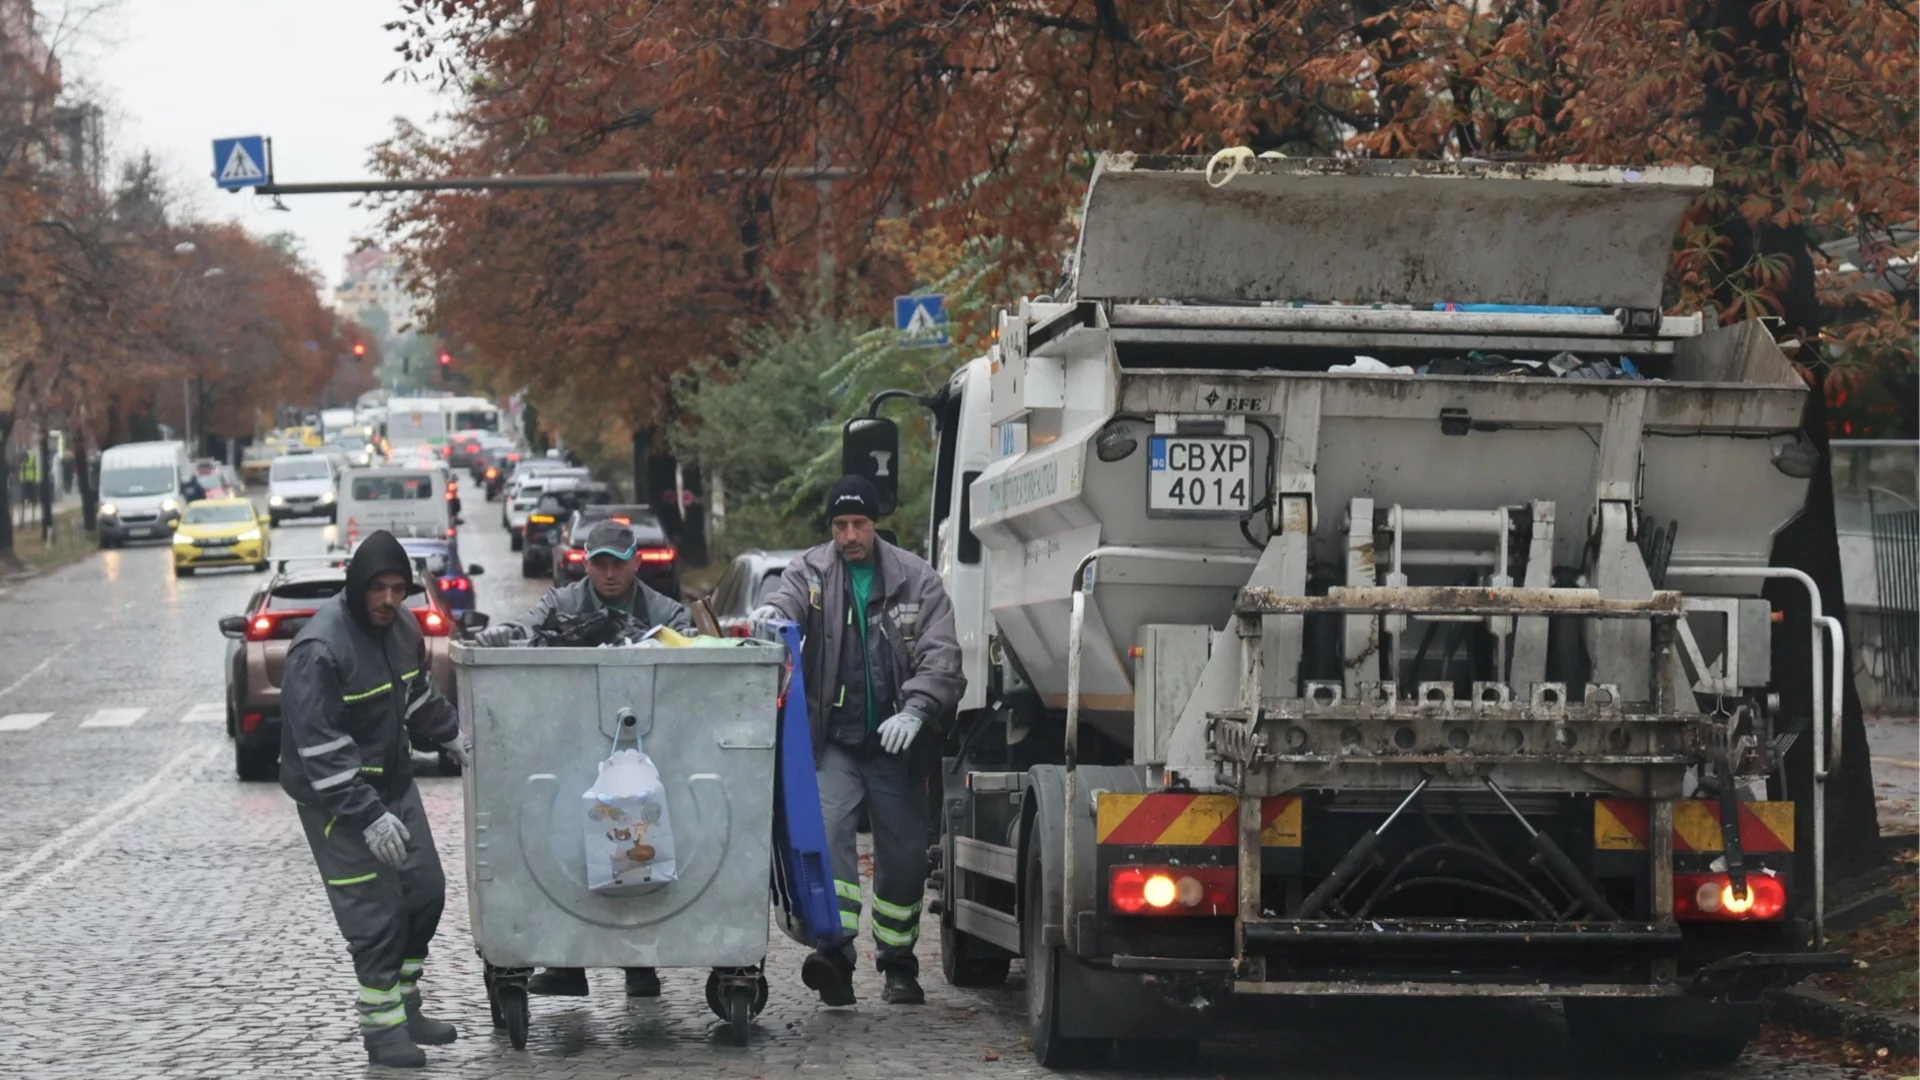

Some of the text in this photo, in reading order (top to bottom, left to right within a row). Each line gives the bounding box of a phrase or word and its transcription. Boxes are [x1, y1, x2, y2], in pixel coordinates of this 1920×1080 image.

[1226, 398, 1262, 411] EFE
[1152, 459, 1165, 467] BG
[1168, 477, 1246, 506] 4014
